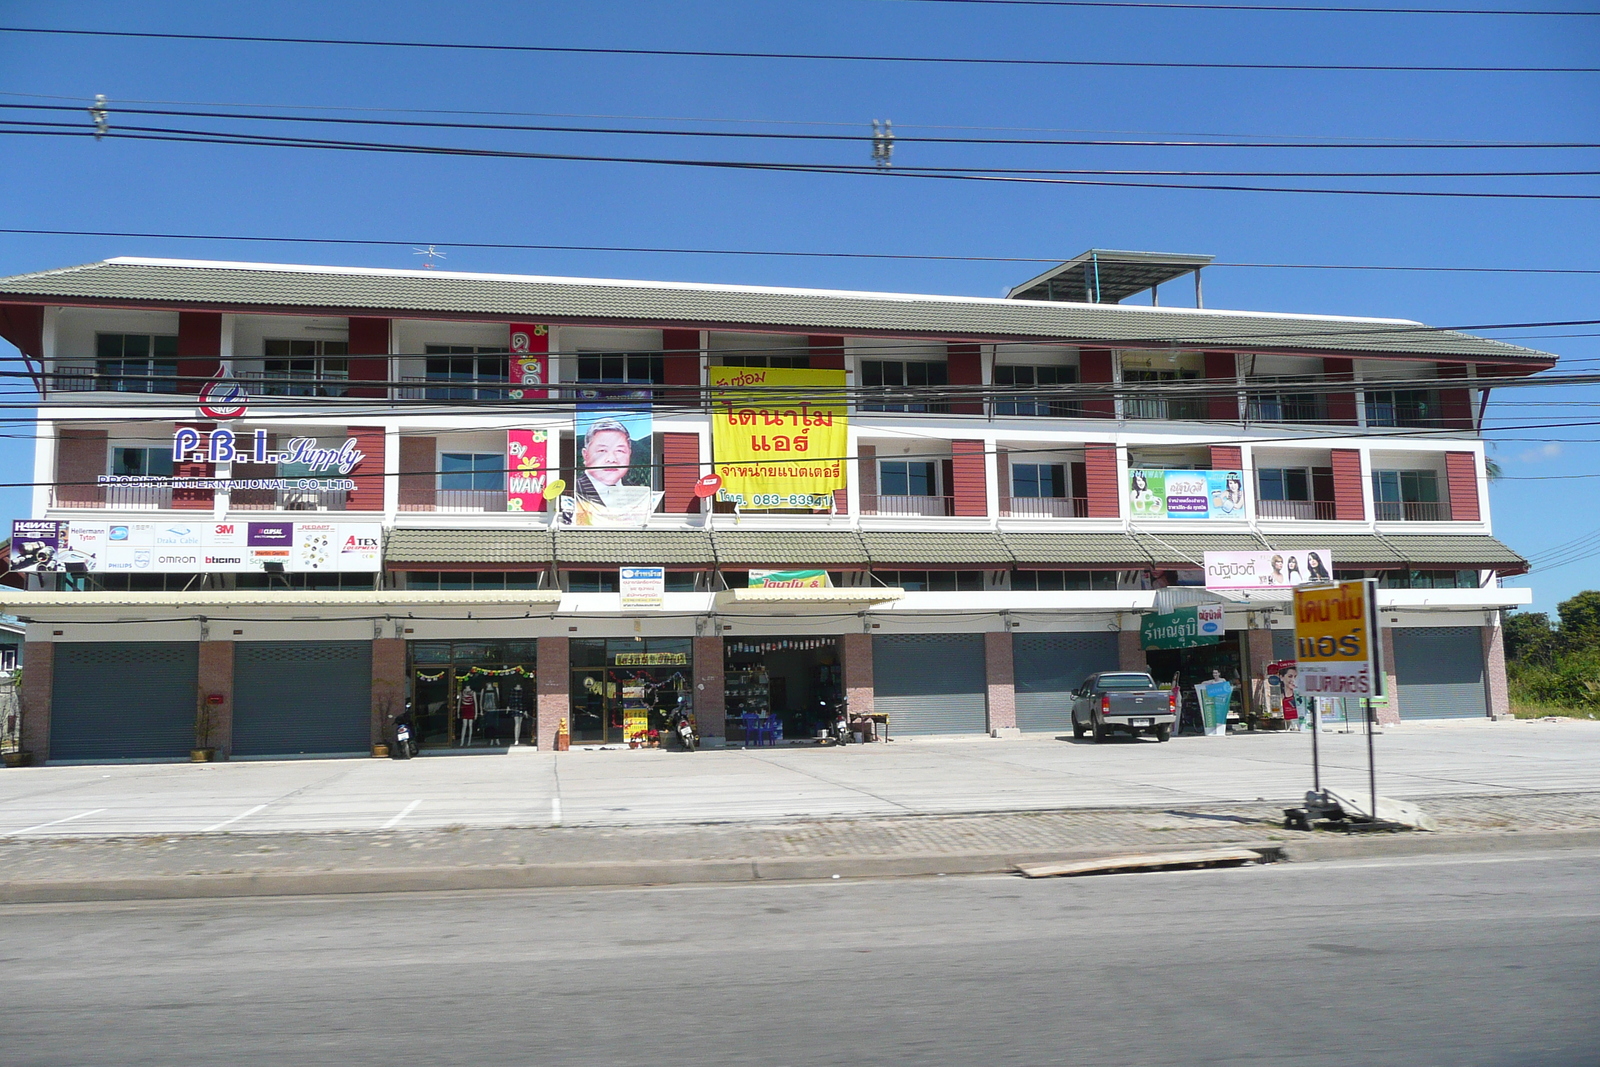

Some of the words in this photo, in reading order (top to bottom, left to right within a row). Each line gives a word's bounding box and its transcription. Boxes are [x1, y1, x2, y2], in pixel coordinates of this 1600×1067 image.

[721, 400, 833, 427] ไดนาโม
[751, 428, 810, 452] แอร์
[173, 428, 279, 462] P.B.I.
[280, 437, 364, 474] Supply
[509, 442, 527, 459] By
[721, 460, 840, 478] จำหน่ายแบตเตอรี่
[172, 478, 290, 491] INTERNATIONAL
[510, 475, 545, 494] WAN
[15, 522, 56, 531] HAWKE
[215, 524, 234, 534] 3M
[205, 556, 240, 564] bticino
[1208, 559, 1256, 579] ณัฐบิวตี้
[809, 580, 819, 588] &
[1145, 617, 1197, 647] ร้านณัฐบิ
[1298, 628, 1362, 658] แอร์
